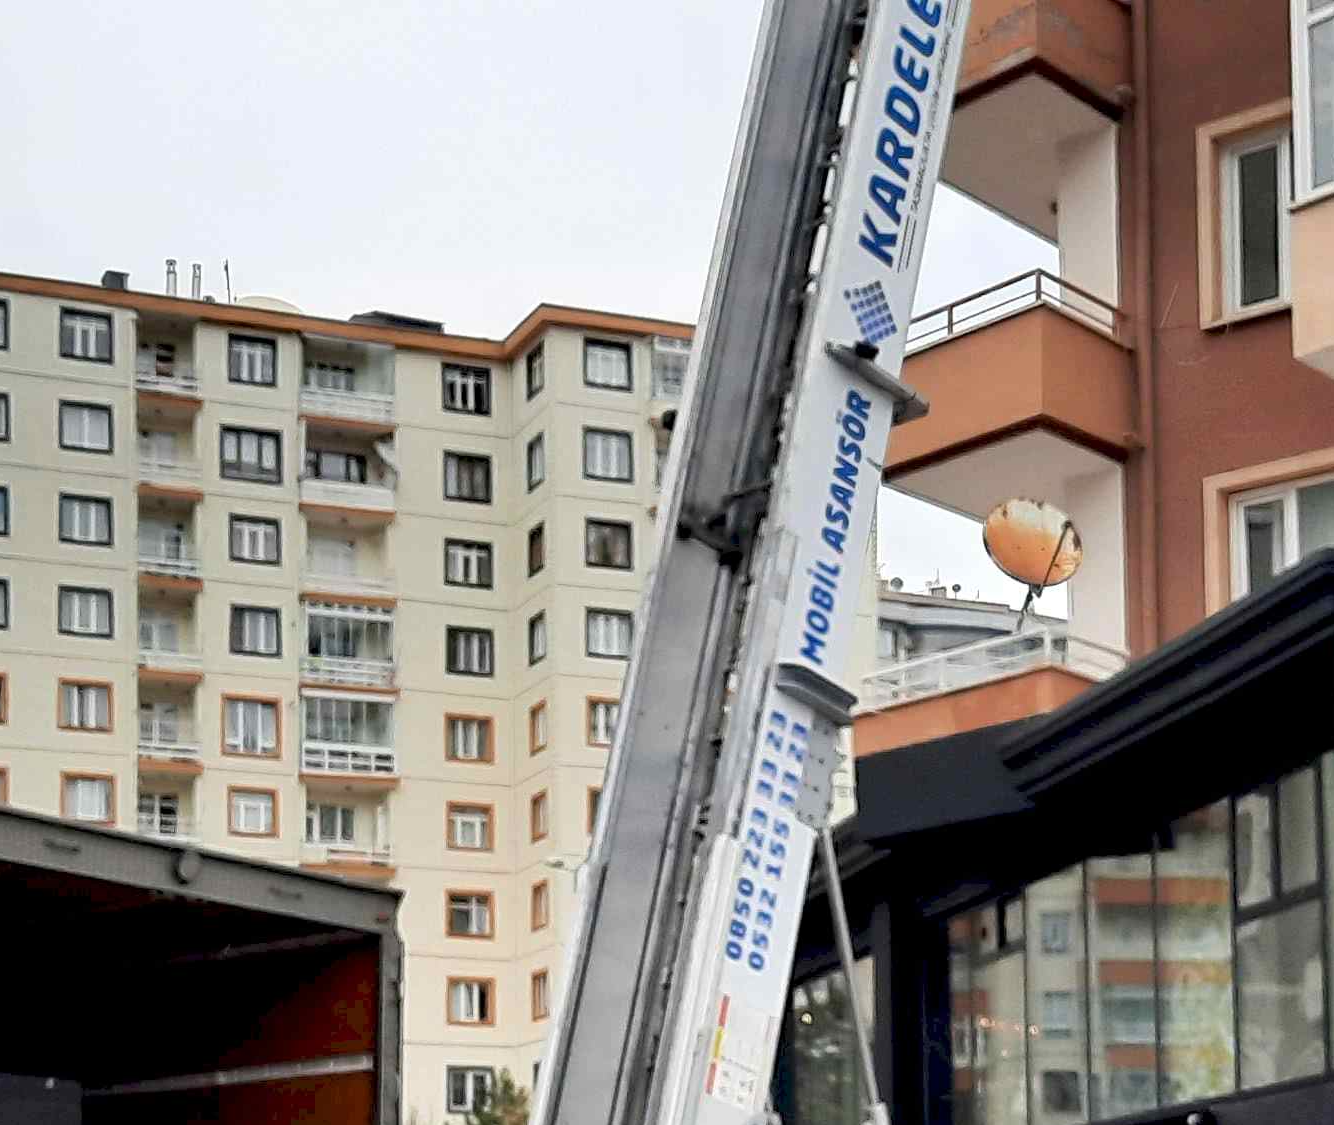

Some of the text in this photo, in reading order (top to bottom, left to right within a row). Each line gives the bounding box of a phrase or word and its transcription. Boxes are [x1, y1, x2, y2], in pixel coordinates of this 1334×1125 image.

[800, 388, 873, 666] MOBİL ASANSÖR
[724, 709, 789, 962] 0850 223 33 23
[747, 888, 778, 972] 0532
[765, 819, 792, 882] 155
